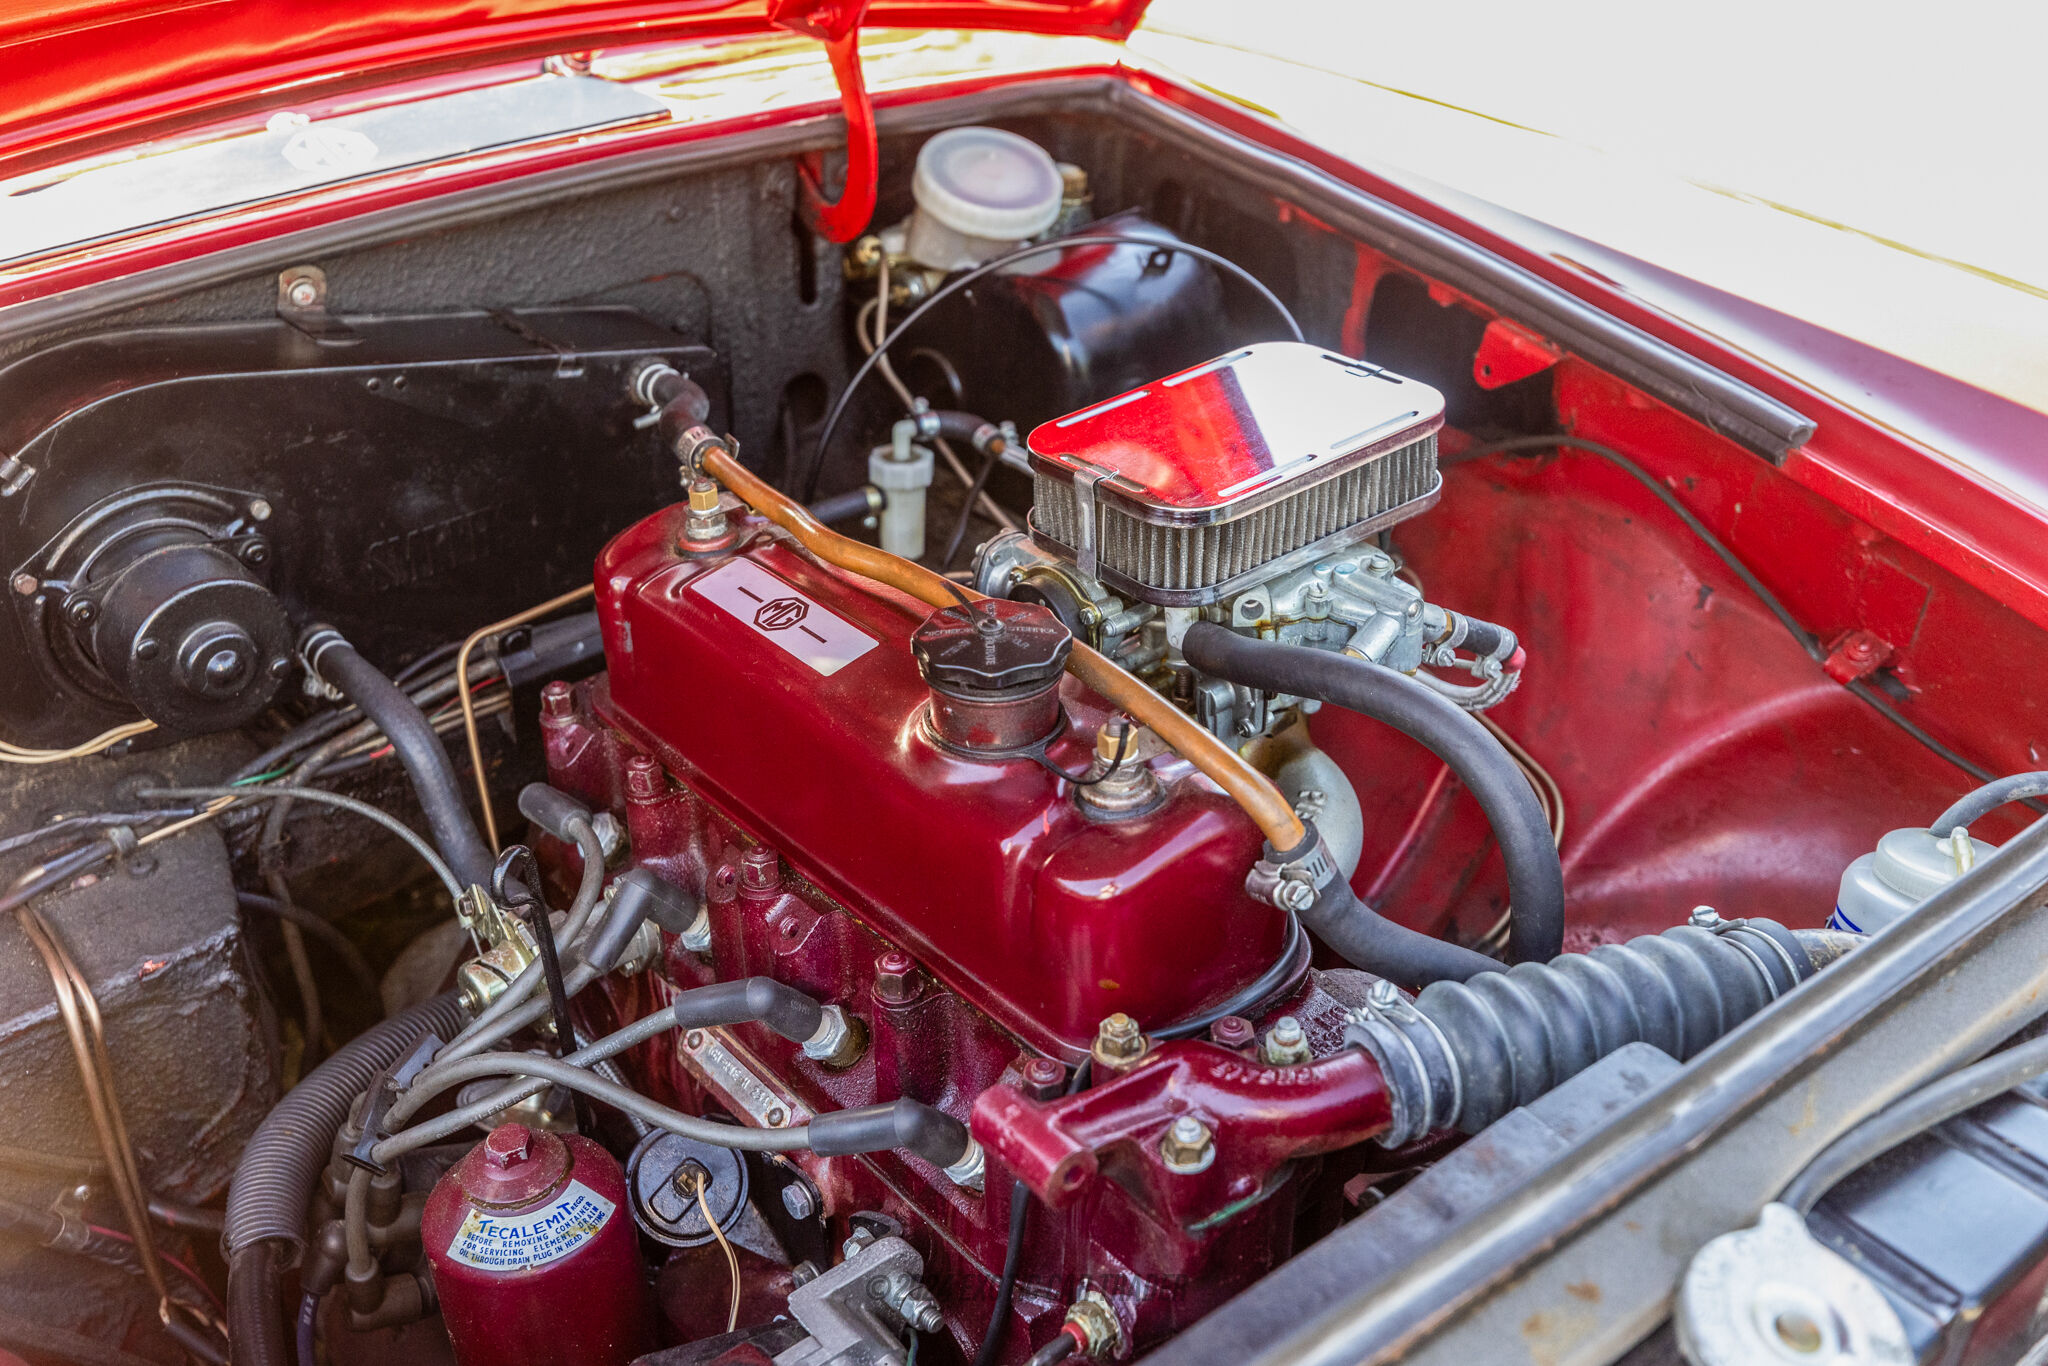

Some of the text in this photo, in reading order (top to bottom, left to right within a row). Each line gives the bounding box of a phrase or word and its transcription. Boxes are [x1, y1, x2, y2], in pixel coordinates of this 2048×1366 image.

[758, 599, 806, 628] MG
[458, 1211, 606, 1266] OIL THROUGH DRAIN PLUG IN HEAD CASTING
[462, 1240, 477, 1249] FOR
[480, 1246, 524, 1256] SERVICING
[577, 1205, 599, 1228] DRAIN
[466, 1201, 593, 1248] BEFORE REMOVING CONTAINER
[479, 1202, 573, 1240] TECALEMIT
